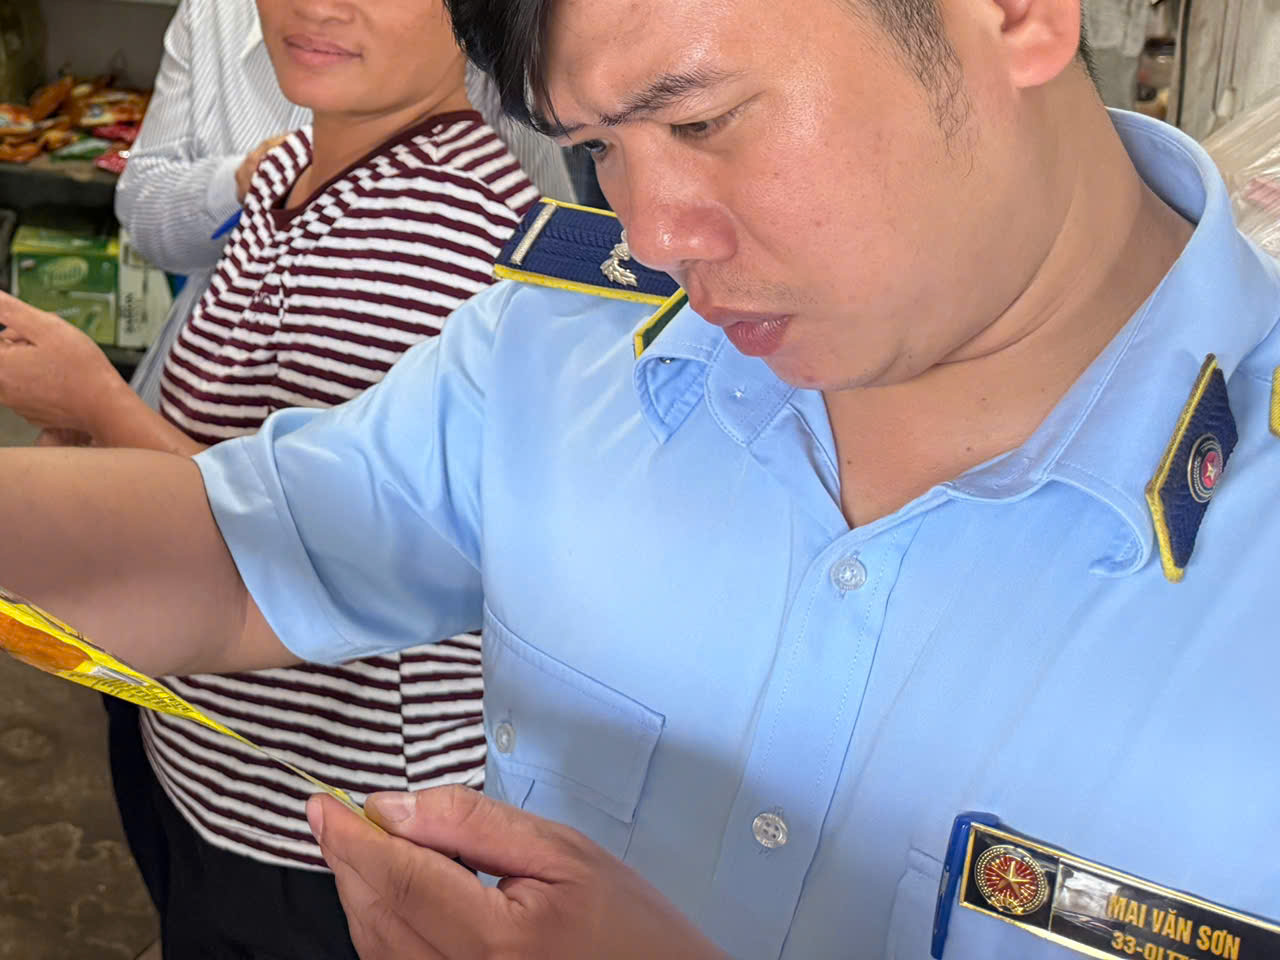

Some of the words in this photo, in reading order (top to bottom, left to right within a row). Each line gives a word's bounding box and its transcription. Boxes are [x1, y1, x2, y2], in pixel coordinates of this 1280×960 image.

[1107, 895, 1148, 929] MAI
[1152, 908, 1194, 945] VĂN
[1196, 924, 1242, 960] SƠN
